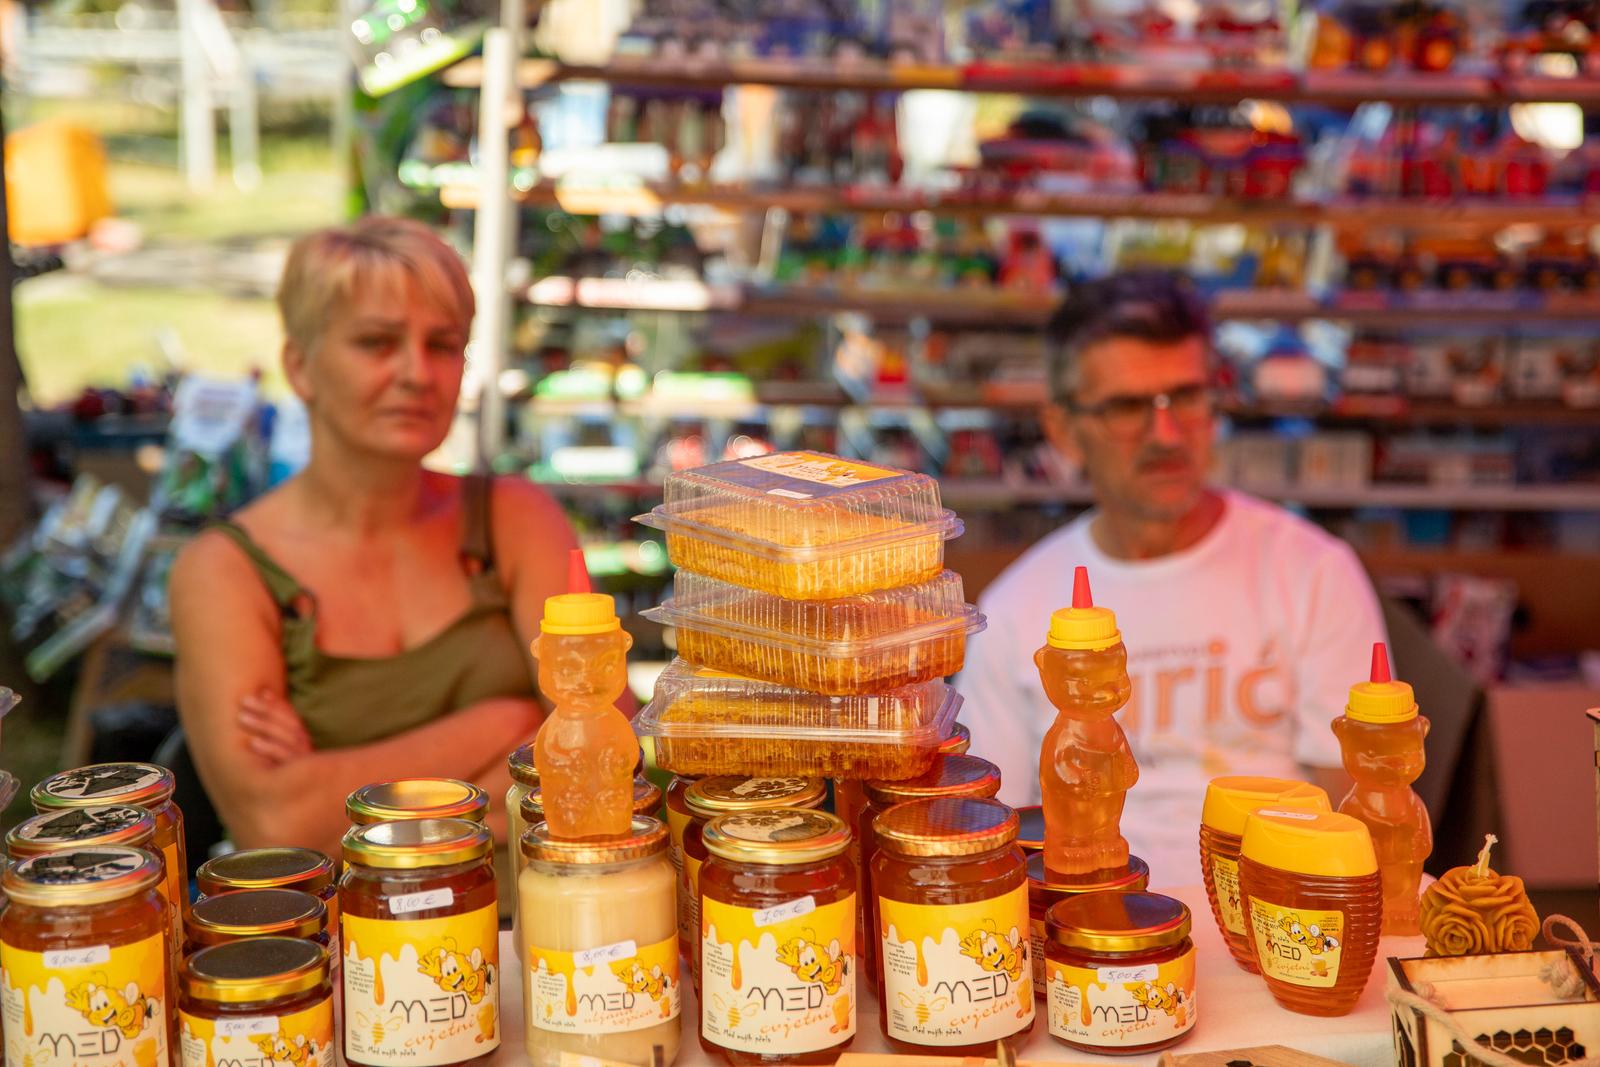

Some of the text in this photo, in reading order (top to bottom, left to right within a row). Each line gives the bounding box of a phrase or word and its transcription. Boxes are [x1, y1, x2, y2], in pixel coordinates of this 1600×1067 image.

[1266, 940, 1302, 961] MED
[579, 992, 636, 1011] MED
[747, 985, 824, 1011] MED
[934, 973, 1009, 1004] MED
[390, 993, 468, 1024] MED
[760, 1004, 831, 1038] cvjetni
[950, 991, 1016, 1029] cvjetni
[1093, 1004, 1149, 1023] MED
[38, 1028, 121, 1057] MED
[404, 1014, 475, 1051] cvjetni
